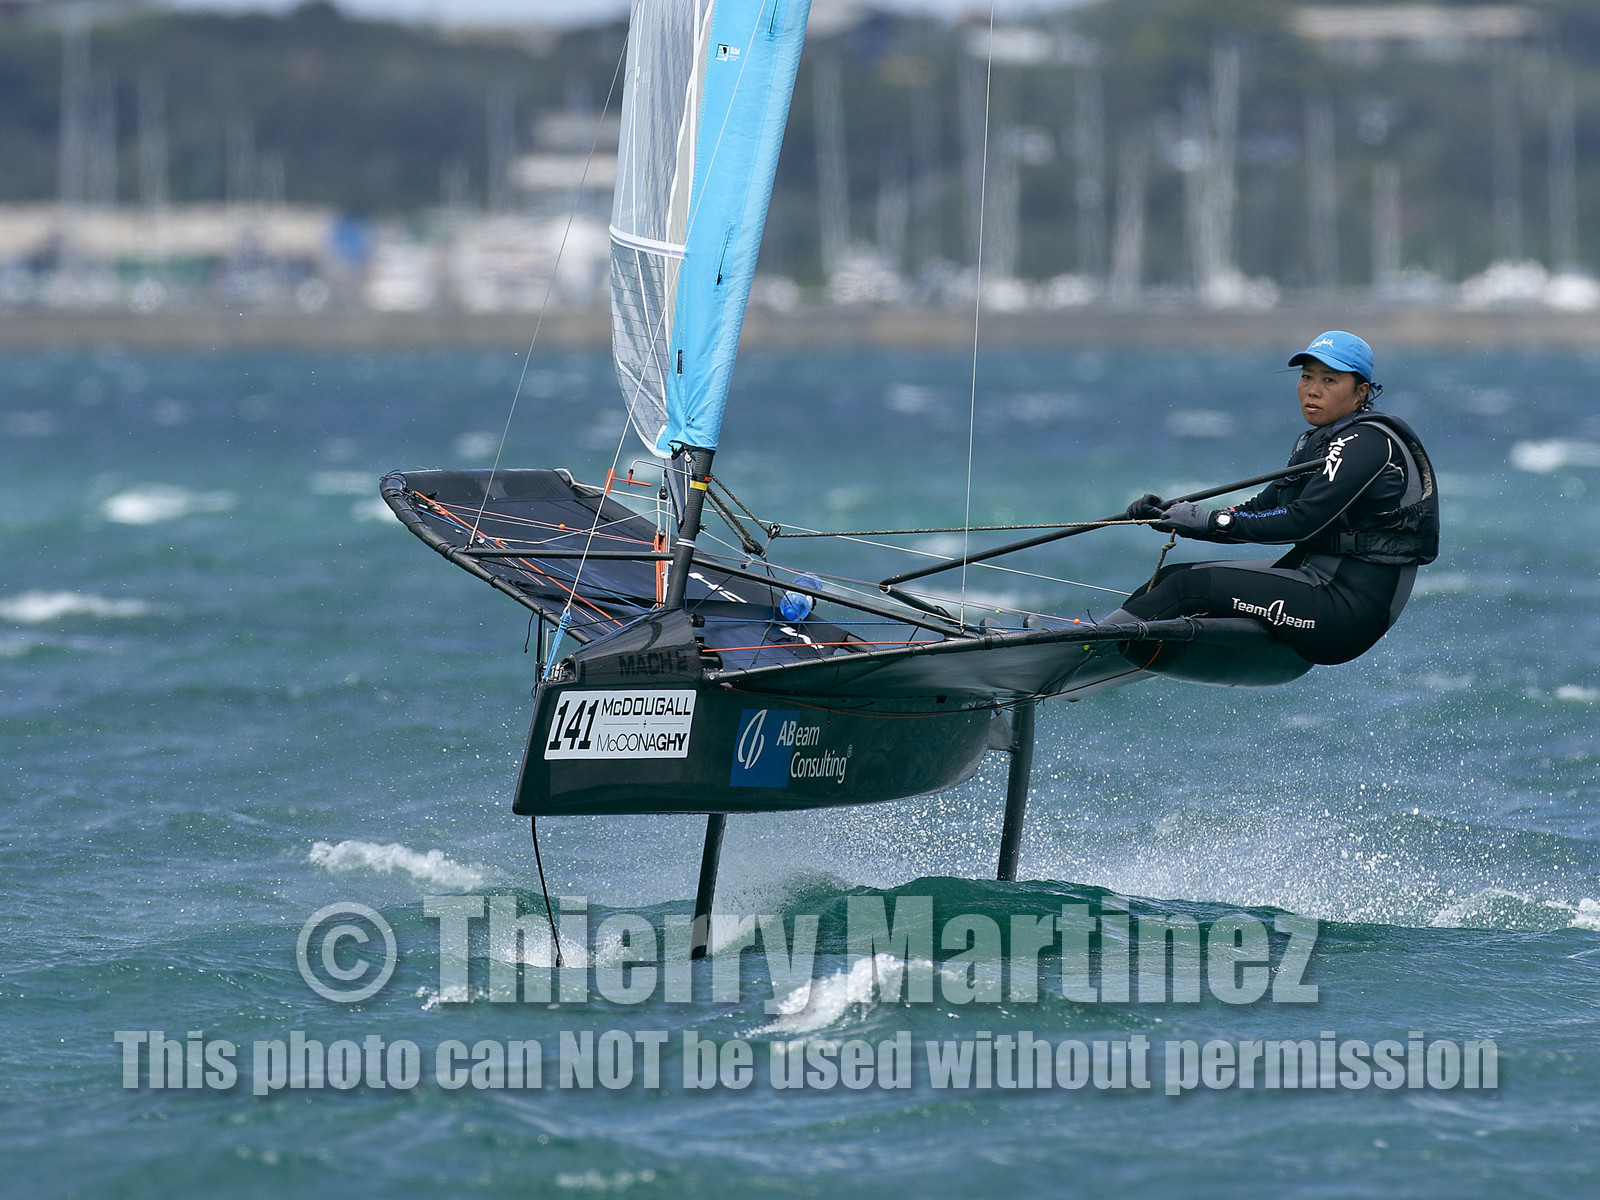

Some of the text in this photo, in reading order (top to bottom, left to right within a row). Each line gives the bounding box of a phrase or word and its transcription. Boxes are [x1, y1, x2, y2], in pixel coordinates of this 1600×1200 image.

[1232, 597, 1267, 618] Team
[601, 697, 692, 717] McDOUGALL
[548, 700, 600, 750] 141
[776, 720, 820, 746] ABeam
[596, 733, 688, 752] McCONAGHY
